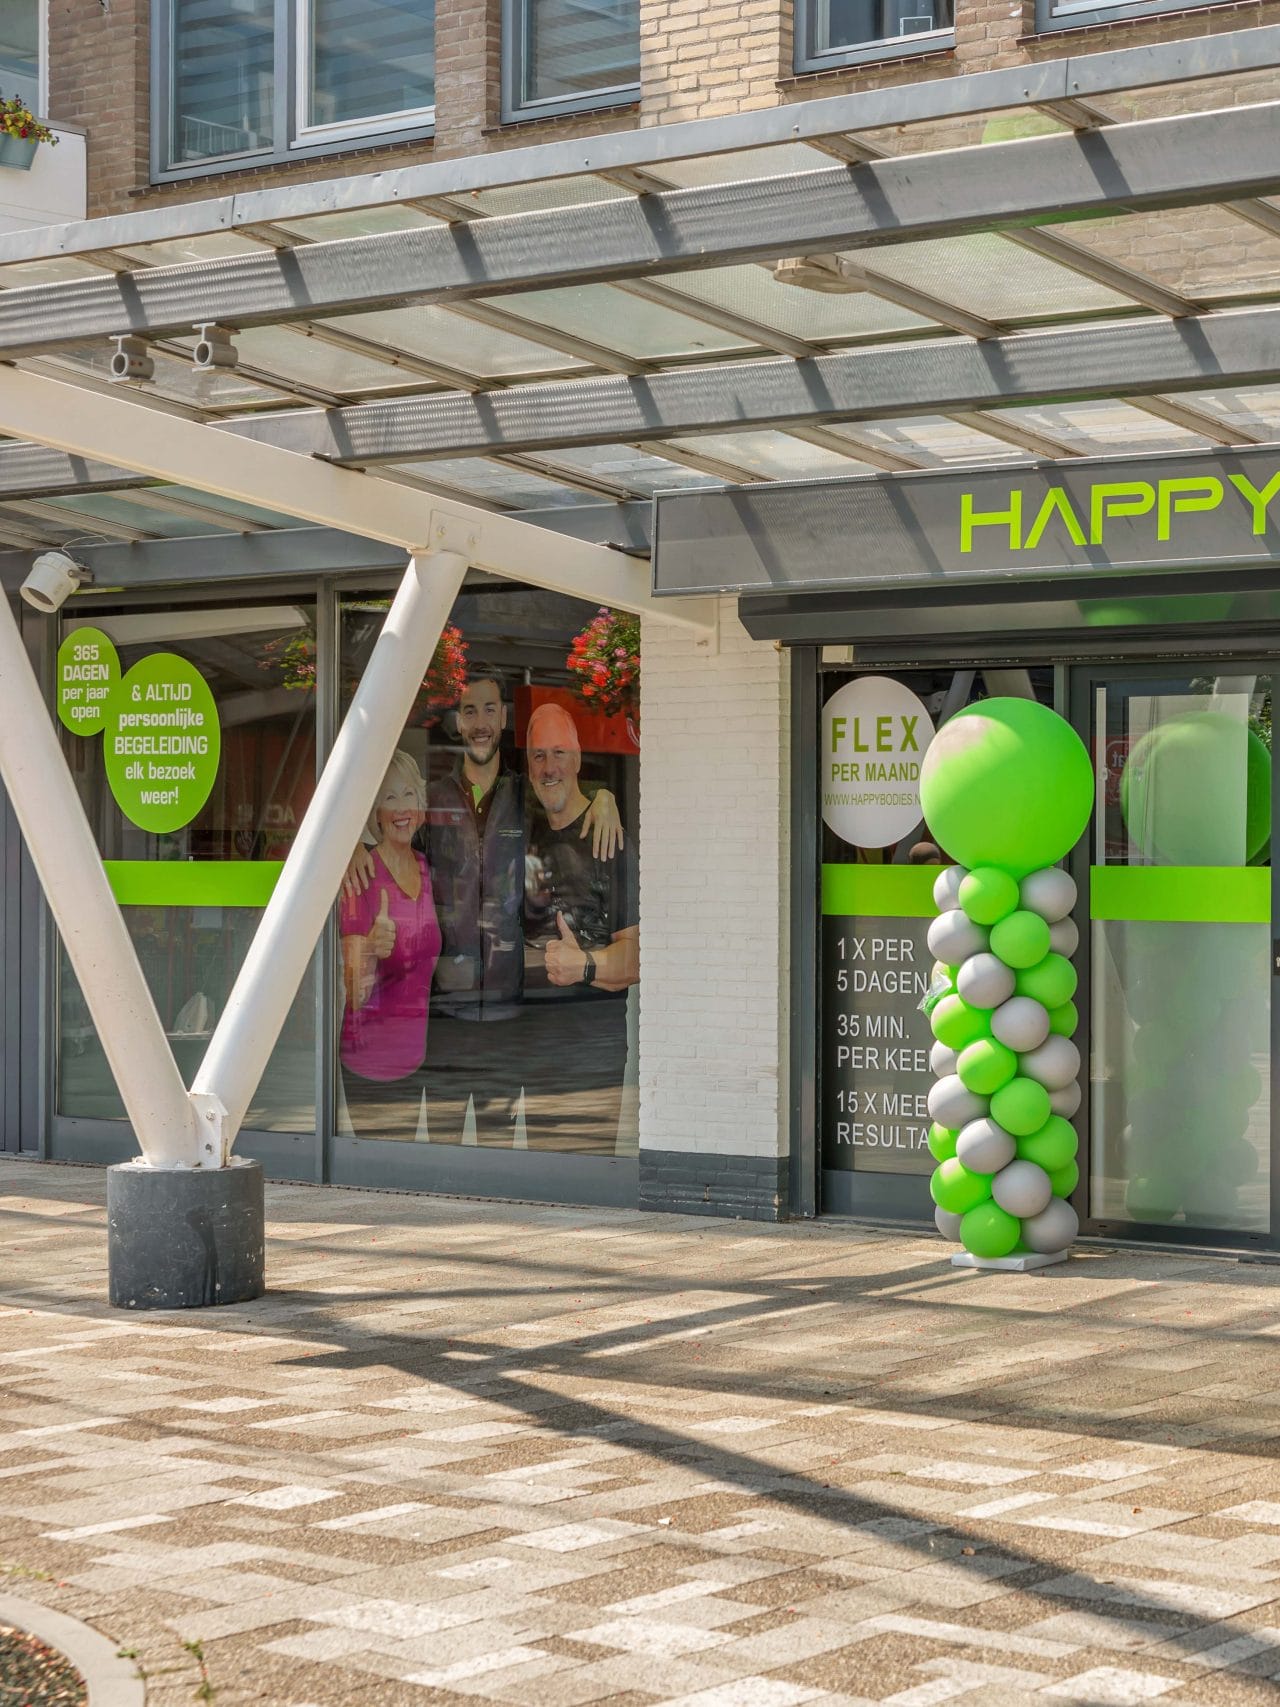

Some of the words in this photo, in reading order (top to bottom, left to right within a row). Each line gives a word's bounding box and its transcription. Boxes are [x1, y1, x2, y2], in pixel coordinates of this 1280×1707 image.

[73, 645, 99, 661] 365
[63, 665, 109, 681] DAGEN
[62, 687, 84, 703] per
[86, 684, 110, 703] jaar
[131, 685, 142, 701] &
[145, 684, 192, 701] ALTIJD
[71, 705, 100, 722] open
[119, 708, 204, 731] persoonlijke
[831, 715, 919, 753] FLEX
[114, 736, 208, 755] BEGELEIDING
[125, 762, 144, 780] elk
[148, 761, 196, 780] bezoek
[831, 763, 860, 782] PER
[865, 762, 920, 782] MAAND
[140, 787, 179, 805] weer!
[824, 793, 921, 807] WWW.HAPPYBODIES.N
[837, 937, 846, 960] 1
[852, 938, 866, 960] X
[871, 938, 915, 962] PER
[837, 969, 848, 992] 5
[853, 970, 929, 994] DAGEN
[837, 1014, 860, 1037] 35
[866, 1015, 910, 1039] MIN.
[837, 1046, 879, 1070] PER
[885, 1048, 932, 1072] KEE
[837, 1090, 858, 1114] 15
[864, 1092, 877, 1114] X
[883, 1093, 927, 1117] MEE
[837, 1122, 929, 1149] RESULTA
